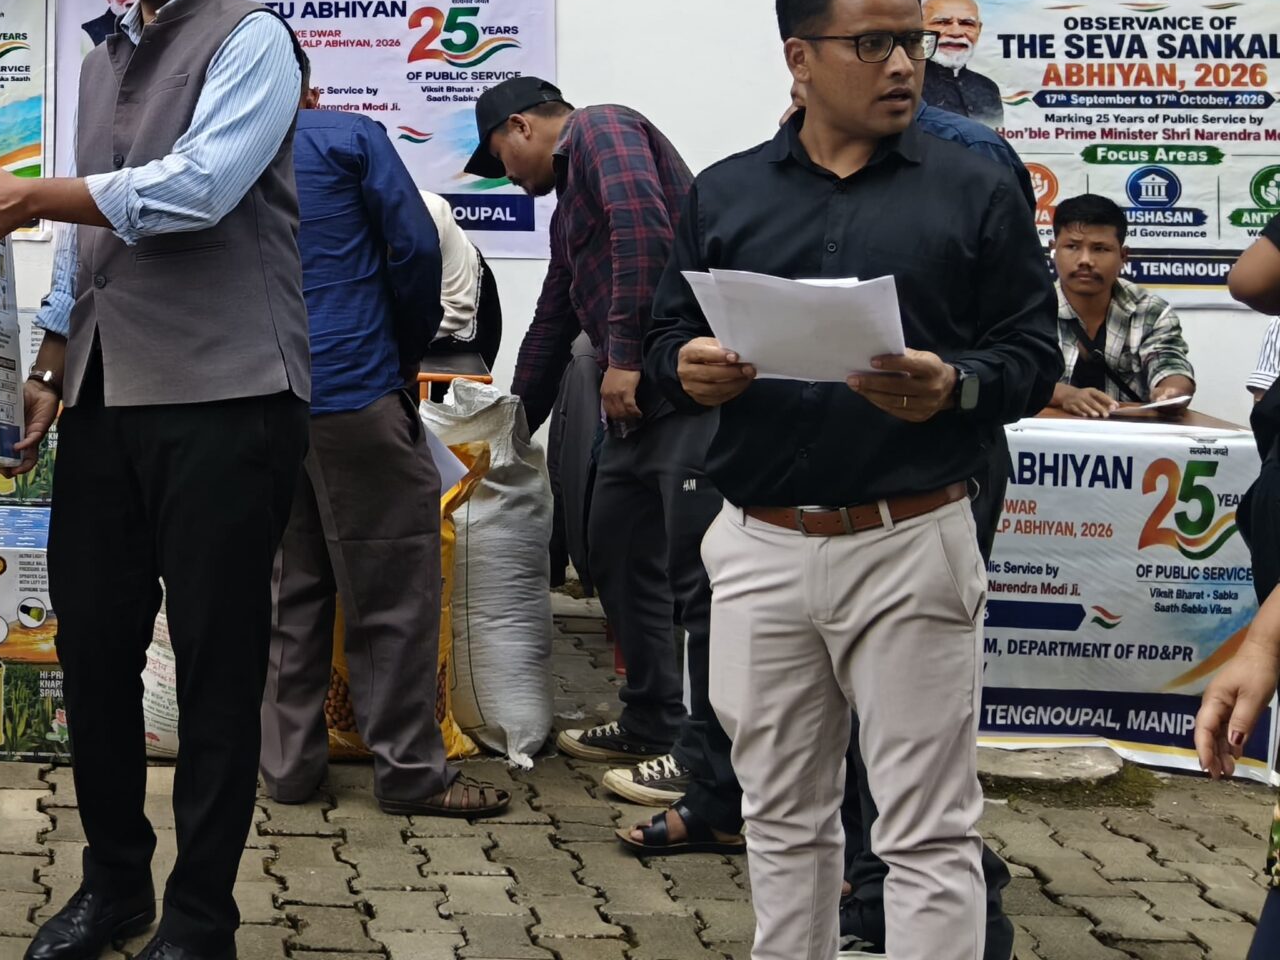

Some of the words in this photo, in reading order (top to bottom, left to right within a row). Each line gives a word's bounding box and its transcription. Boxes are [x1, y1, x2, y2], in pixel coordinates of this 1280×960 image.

[301, 0, 407, 19] ABHIYAN
[1064, 16, 1204, 30] OBSERVANCE
[1209, 16, 1237, 30] OF
[310, 29, 342, 38] DWAR
[407, 6, 480, 63] 25
[481, 26, 519, 35] YEARS
[325, 39, 373, 48] ABHIYAN,
[376, 39, 401, 47] 2026
[997, 34, 1055, 58] THE
[1064, 33, 1148, 59] SEVA
[1157, 33, 1280, 59] SANKAL
[406, 72, 422, 81] OF
[425, 71, 468, 81] PUBLIC
[471, 71, 521, 81] SERVICE
[1042, 63, 1186, 90] ABHIYAN,
[1194, 63, 1268, 87] 2026
[327, 86, 364, 95] Service
[366, 86, 378, 96] by
[362, 102, 388, 111] Modi
[390, 102, 401, 111] Ji.
[1045, 93, 1067, 104] 17th
[1070, 93, 1137, 106] September
[1139, 95, 1152, 105] to
[1156, 94, 1177, 105] 17th
[1180, 95, 1232, 106] October,
[1235, 95, 1265, 105] 2026
[1045, 113, 1093, 125] Marking
[1096, 114, 1110, 123] 25
[1113, 114, 1145, 123] Years
[1148, 114, 1160, 124] of
[1163, 114, 1199, 124] Public
[1202, 114, 1247, 124] Service
[1249, 114, 1264, 126] by
[1055, 127, 1097, 140] Prime
[1101, 128, 1158, 140] Minister
[1162, 128, 1191, 141] Shri
[1195, 128, 1261, 141] Narendra
[1097, 147, 1149, 161] Focus
[1154, 147, 1208, 162] Areas
[1125, 211, 1194, 224] USHASAN
[1140, 228, 1207, 238] Governance
[1141, 262, 1231, 277] TENGNOUP
[1138, 457, 1219, 551] 25
[1014, 519, 1078, 539] ABHIYAN,
[1081, 522, 1114, 538] 2026
[1004, 561, 1043, 575] Service
[1046, 563, 1059, 579] by
[1136, 564, 1153, 578] OF
[1155, 564, 1200, 580] PUBLIC
[1202, 566, 1253, 582] SERVICE
[987, 580, 1038, 594] Narendra
[1040, 582, 1068, 595] Modi
[1070, 583, 1081, 596] Ji.
[1150, 587, 1174, 599] Viksit
[1176, 588, 1204, 600] Bharat
[1213, 589, 1239, 601] Sabka
[1154, 602, 1180, 613] Saath
[1181, 603, 1208, 614] Sabka
[1210, 604, 1232, 615] Vikas
[1007, 639, 1112, 659] DEPARTMENT
[1114, 643, 1135, 660] OF
[1137, 644, 1194, 662] RD&PR
[985, 705, 1121, 731] TENGNOUPAL,
[1126, 709, 1196, 736] MANIP
